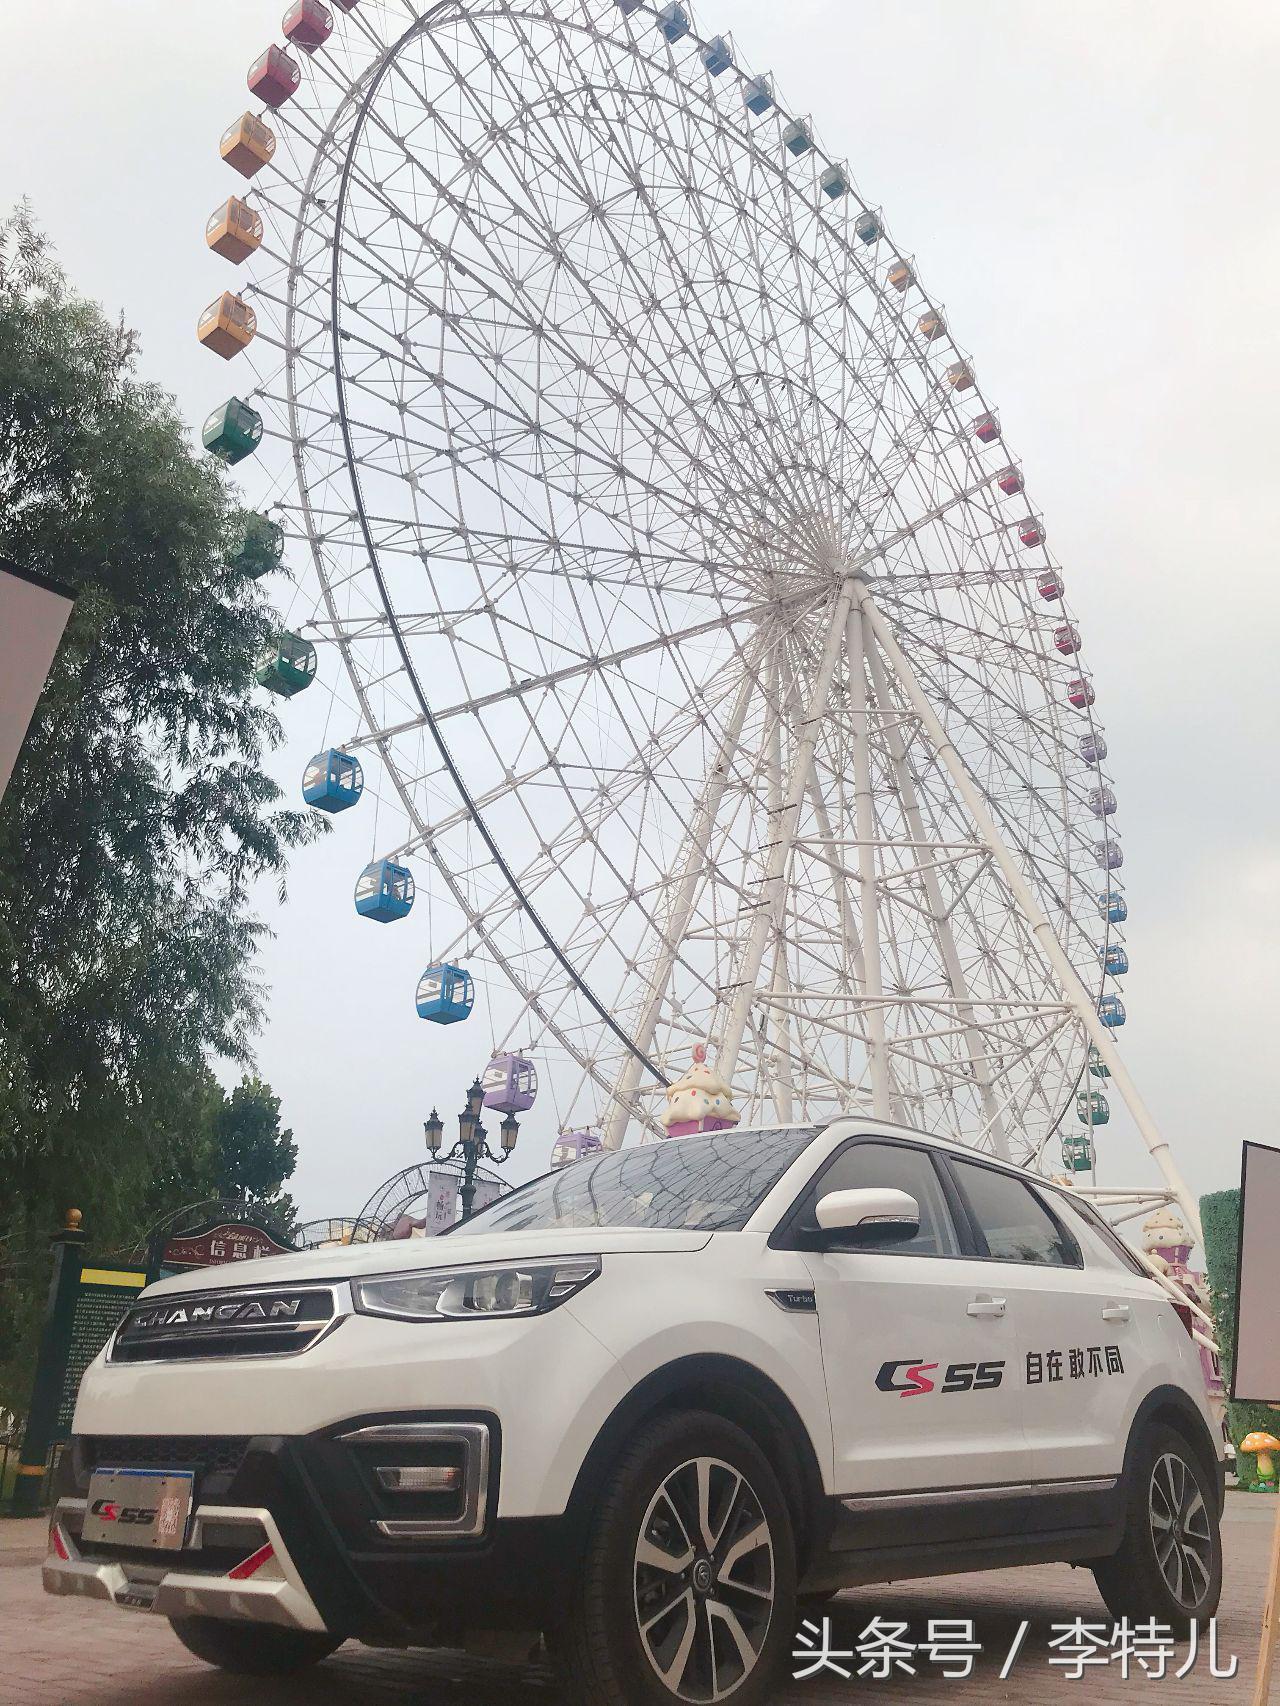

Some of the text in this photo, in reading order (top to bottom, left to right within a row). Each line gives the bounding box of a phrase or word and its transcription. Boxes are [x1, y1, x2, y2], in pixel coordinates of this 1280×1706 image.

[210, 1240, 270, 1260] 信息栏
[787, 1294, 814, 1303] Turbo
[134, 1300, 301, 1327] CHANGAN
[1025, 1345, 1125, 1385] 自在敢不同
